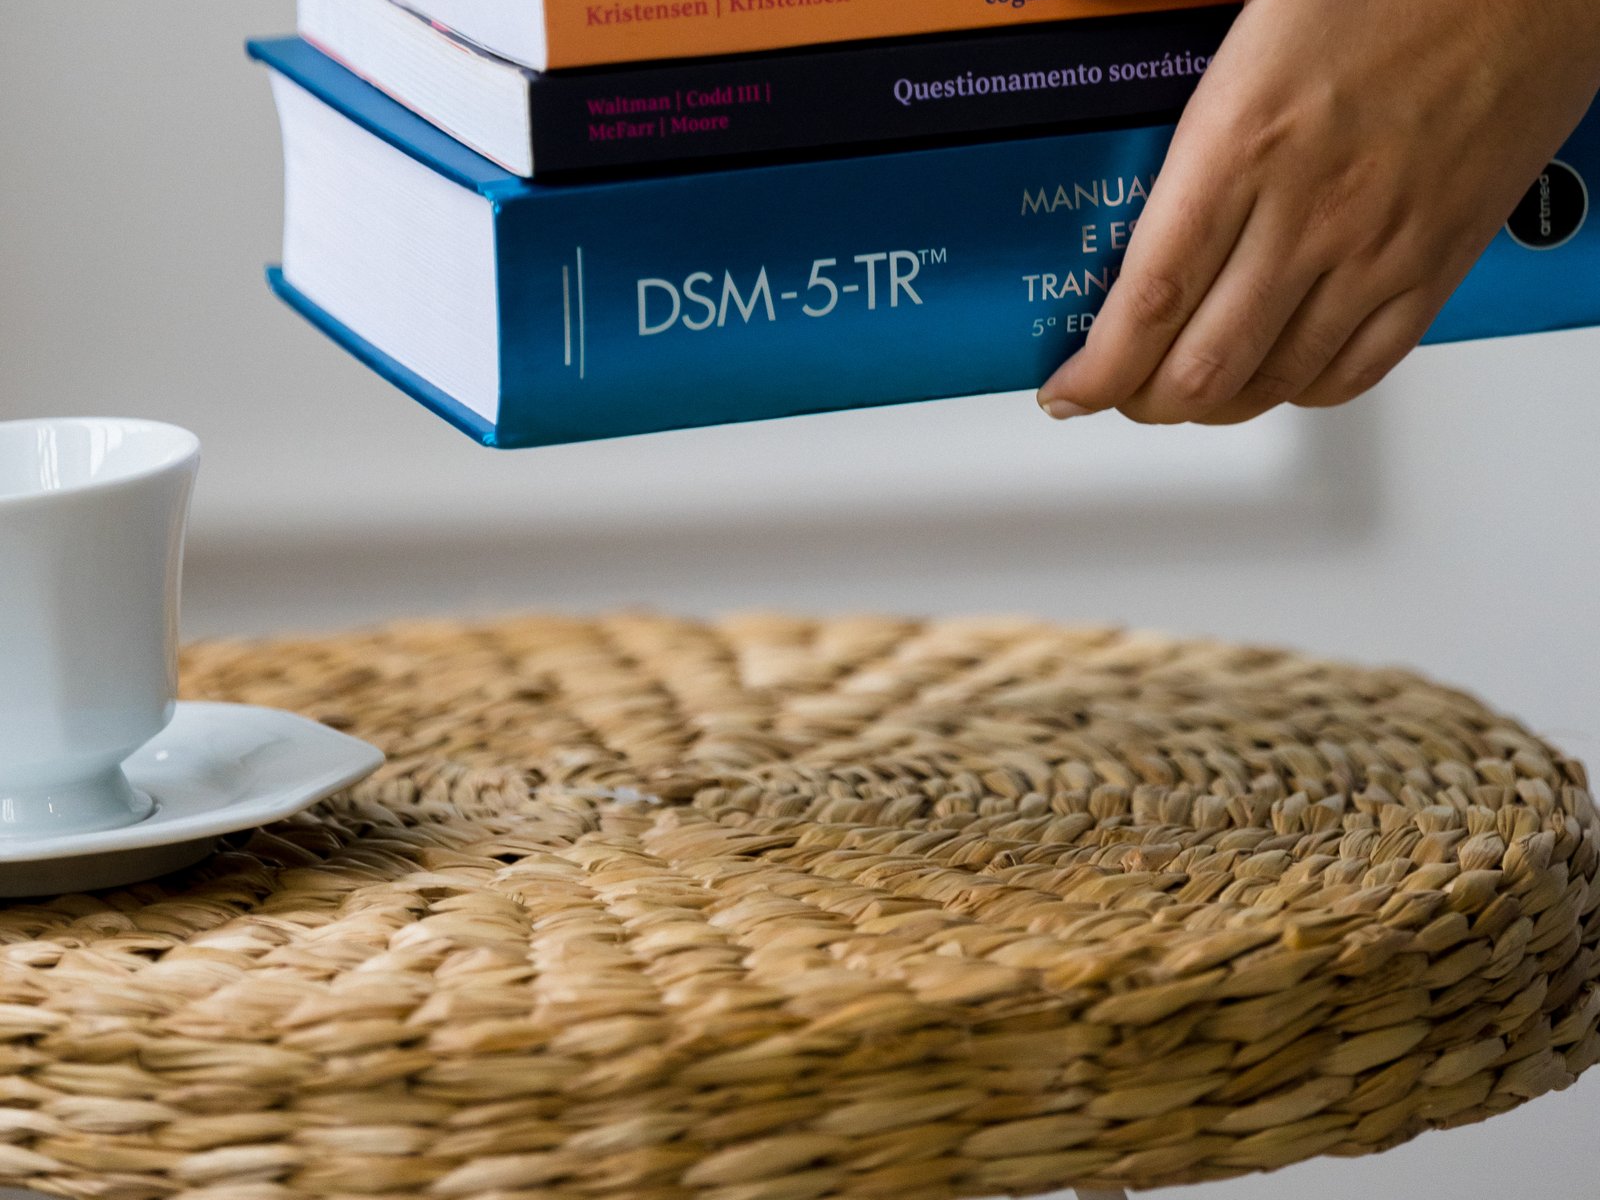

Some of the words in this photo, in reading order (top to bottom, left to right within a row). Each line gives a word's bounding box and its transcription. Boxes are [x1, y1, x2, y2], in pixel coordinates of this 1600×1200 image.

[893, 62, 1103, 105] Questionamento
[586, 95, 671, 116] Waltman
[686, 84, 733, 108] Codd
[588, 120, 656, 141] McFarr
[671, 114, 730, 134] Moore
[1082, 223, 1097, 253] E
